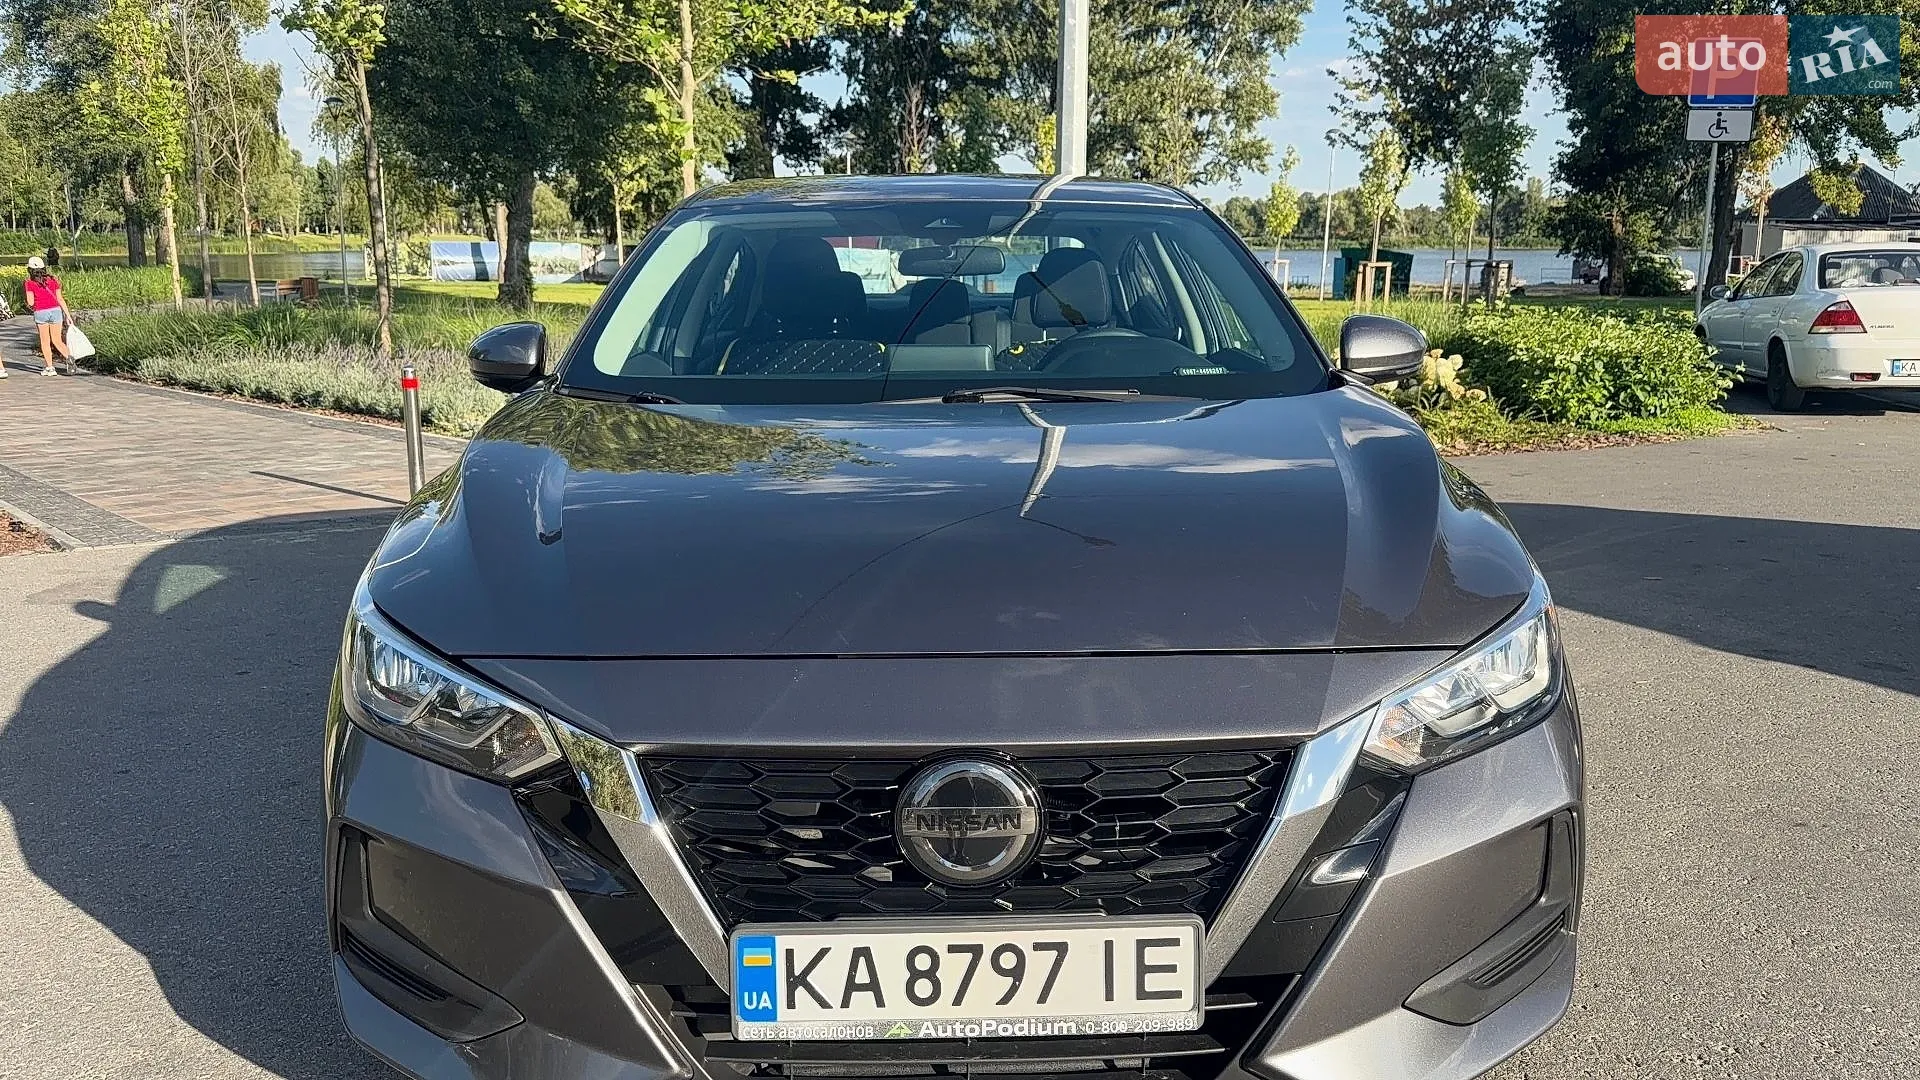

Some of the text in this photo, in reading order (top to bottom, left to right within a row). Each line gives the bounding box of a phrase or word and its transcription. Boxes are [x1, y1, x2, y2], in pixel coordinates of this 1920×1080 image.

[1901, 362, 1917, 372] KA
[916, 813, 1022, 832] NISSAN
[785, 937, 1183, 1010] KA 8797 IE
[743, 991, 773, 1010] UA
[743, 1024, 874, 1039] сеть автосалонов
[918, 1018, 1194, 1038] AutoPodium 0-800-209-989
